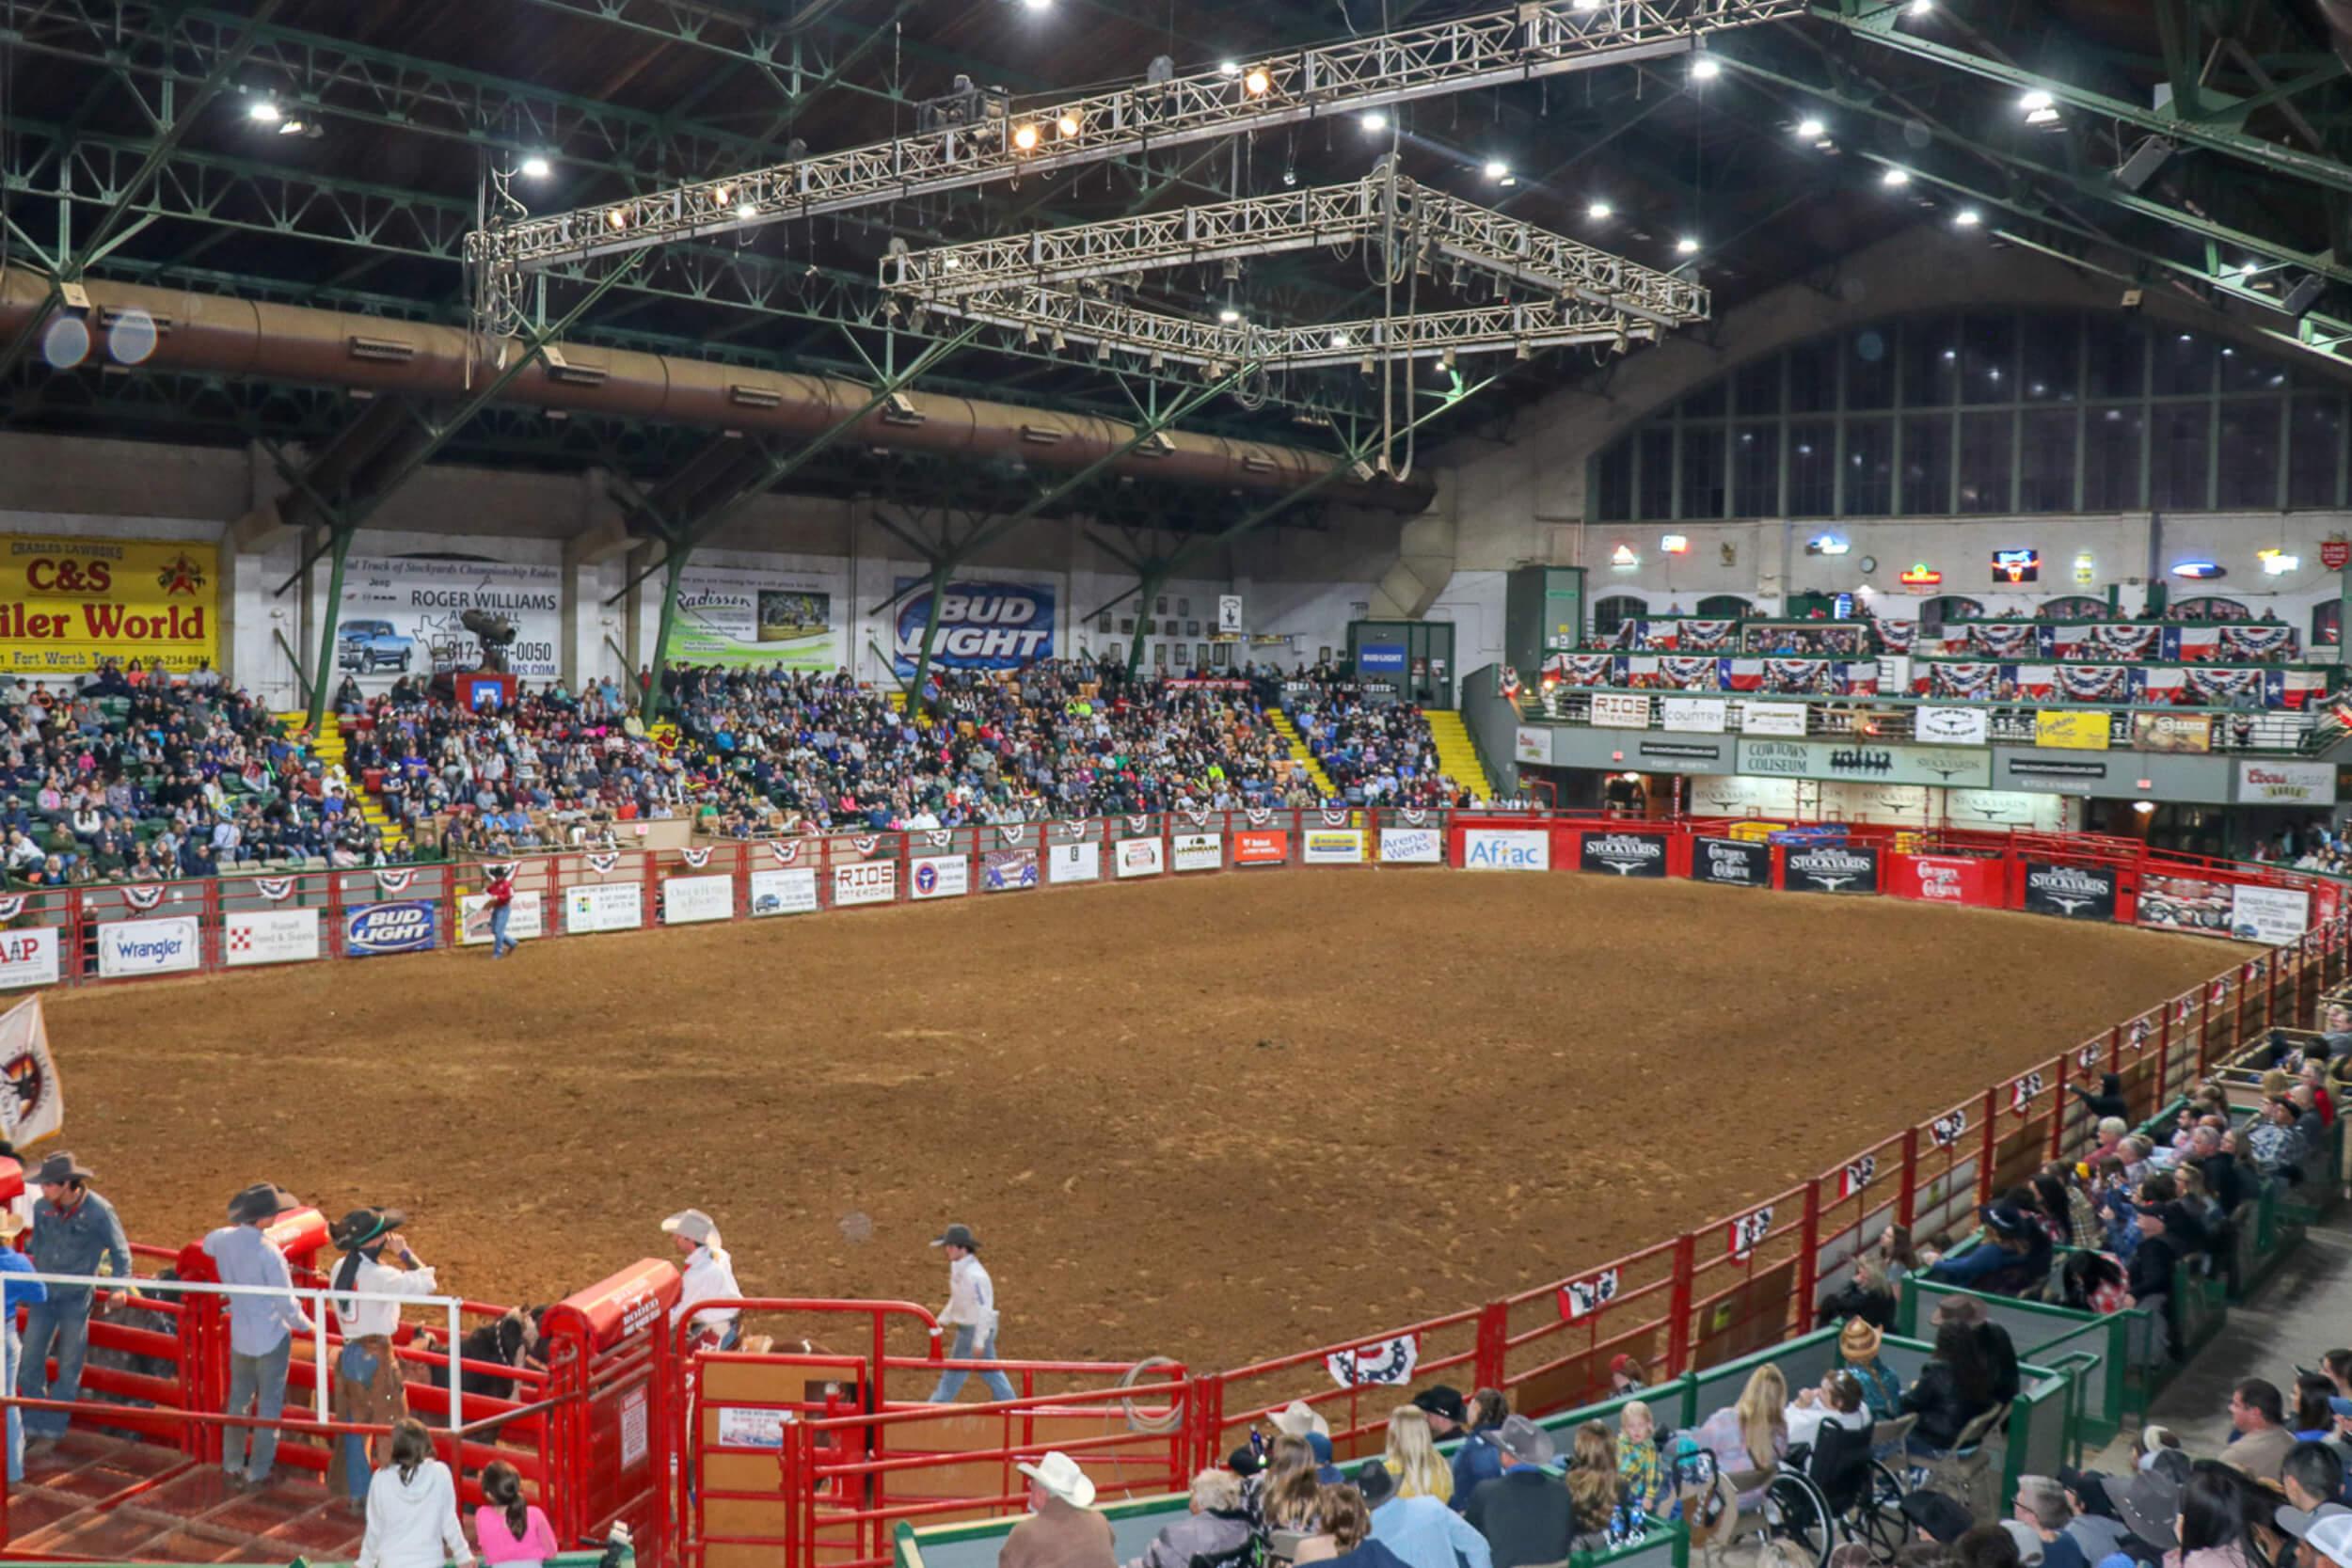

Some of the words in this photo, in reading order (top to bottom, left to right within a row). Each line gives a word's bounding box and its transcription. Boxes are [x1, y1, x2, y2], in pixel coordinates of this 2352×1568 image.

[26, 558, 111, 592] C&S
[411, 590, 469, 608] ROGER
[473, 592, 557, 610] WILLIAMS
[676, 587, 751, 612] Radisson
[938, 594, 1036, 623] BUD
[83, 604, 205, 640] World
[904, 627, 1047, 657] LIGHT
[13, 651, 40, 666] Fort
[44, 651, 86, 666] Worth
[1595, 698, 1647, 714] RIOS
[1749, 744, 1807, 758] COWTOWN
[1748, 758, 1807, 773] COLISEUM
[2248, 768, 2287, 784] Coors
[1383, 833, 1427, 848] Arena
[1586, 841, 1661, 858] STOCKYARDS
[1388, 843, 1430, 860] Werks
[1790, 855, 1871, 871] STOCKYARDS
[837, 865, 893, 888] RIOS
[2029, 872, 2108, 895] STOCKYARDS
[367, 909, 423, 927] BUD
[355, 924, 430, 942] LIGHT
[117, 940, 183, 963] Wrangler
